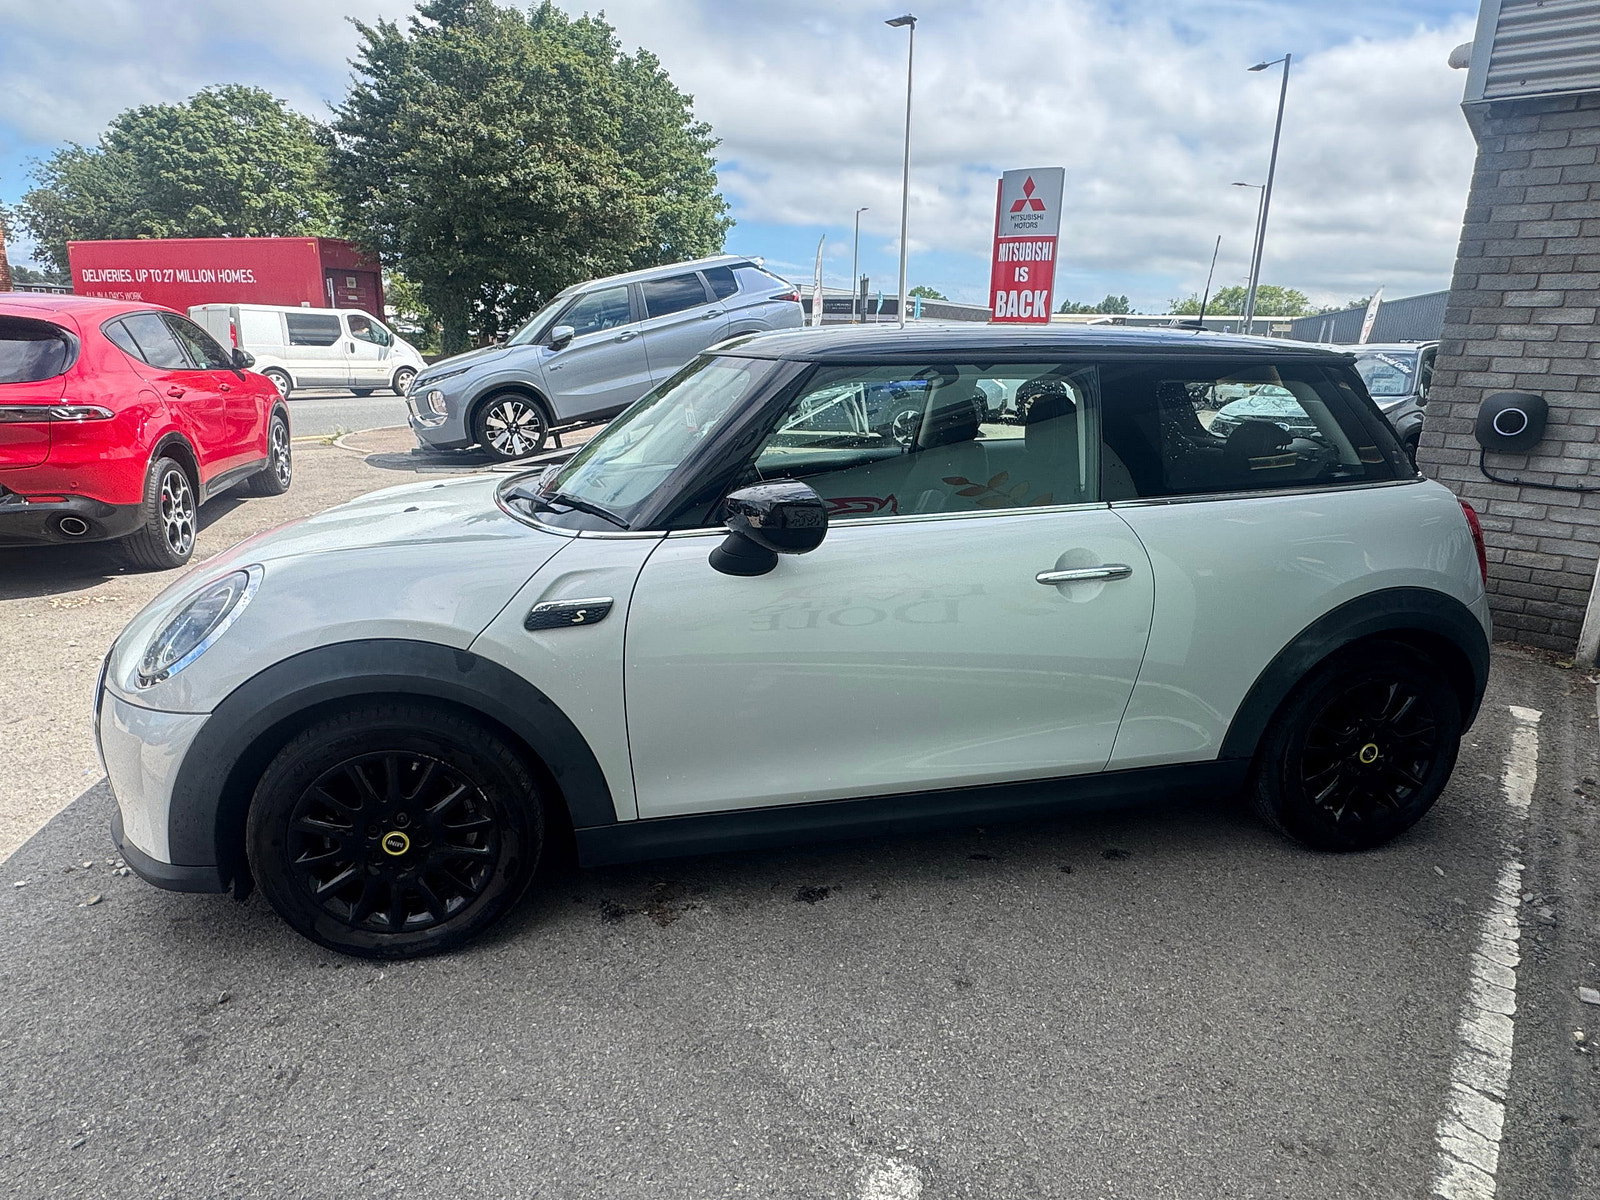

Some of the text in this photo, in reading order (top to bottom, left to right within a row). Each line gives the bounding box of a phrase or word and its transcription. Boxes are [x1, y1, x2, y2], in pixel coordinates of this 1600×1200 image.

[1010, 213, 1044, 221] MITSUBISHI
[998, 241, 1053, 263] MITSUBISHI
[82, 269, 257, 283] DELIVERIES. UP TO 27 MILLION HOMES.
[1014, 266, 1029, 283] IS
[125, 291, 144, 300] WORK
[994, 289, 1049, 318] BACK
[571, 609, 587, 622] S
[387, 839, 404, 848] MINI
